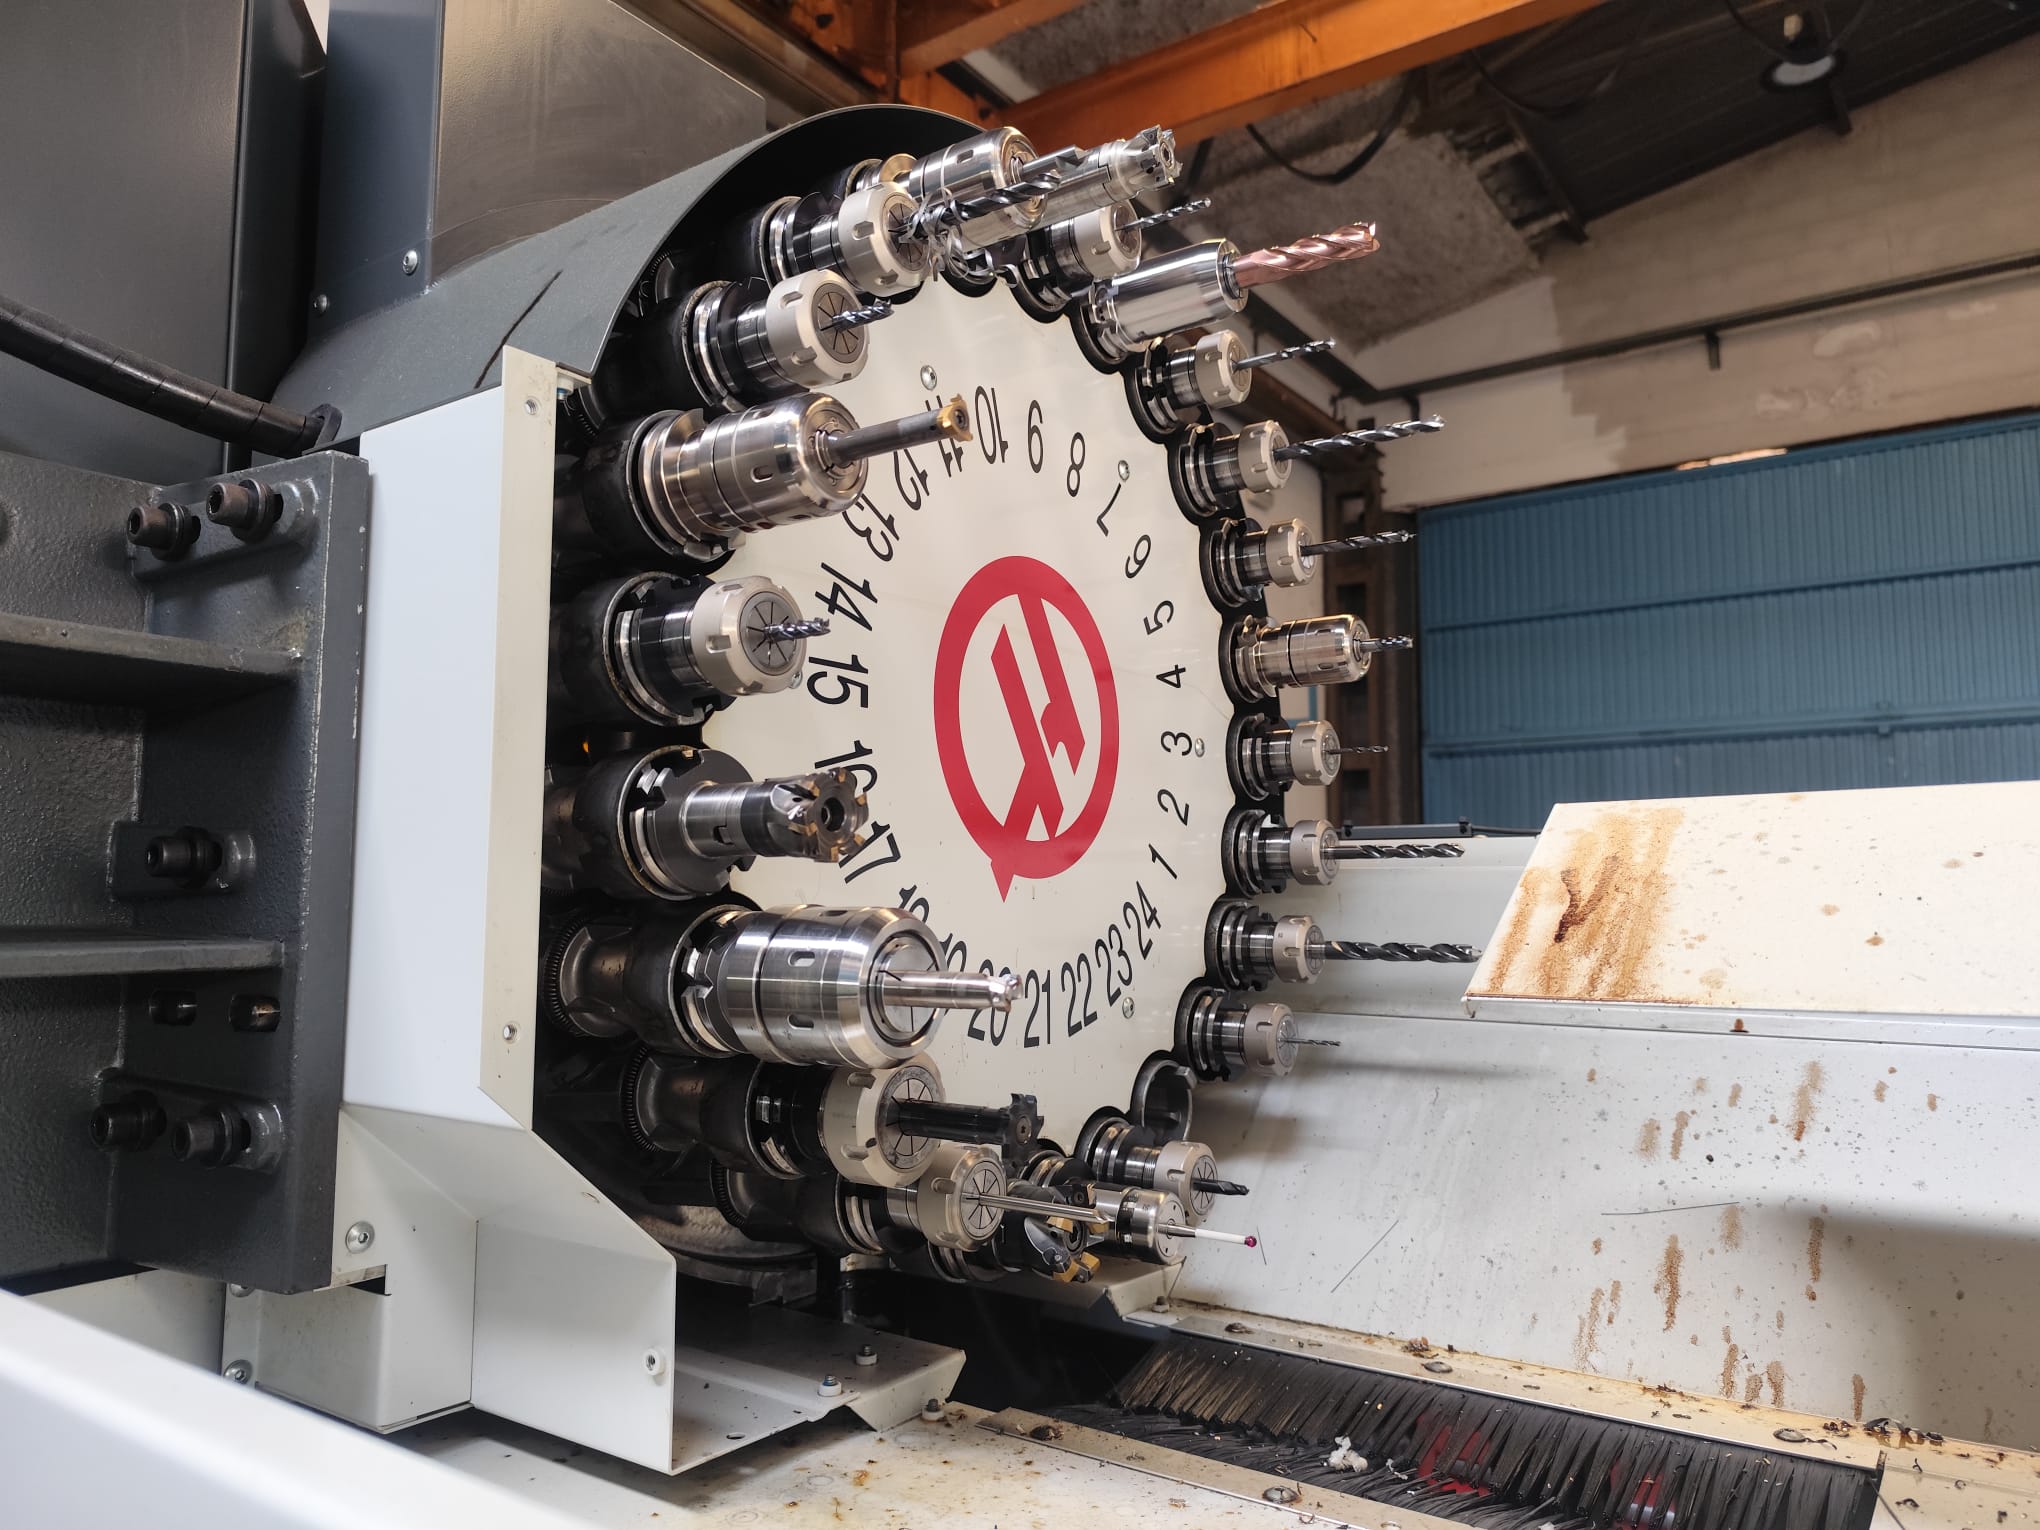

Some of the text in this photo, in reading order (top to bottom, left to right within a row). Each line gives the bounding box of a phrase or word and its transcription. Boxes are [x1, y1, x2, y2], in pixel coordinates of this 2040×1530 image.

[975, 386, 1008, 464] 10
[1028, 400, 1043, 473] 9
[1067, 432, 1085, 497] 8
[842, 494, 899, 561] 13
[1097, 483, 1121, 536] 7
[1126, 535, 1151, 578] 6
[814, 562, 879, 632] 14
[1144, 601, 1174, 635] 5
[807, 653, 869, 708] 15
[1156, 665, 1186, 688] 4
[1161, 731, 1192, 756] 3
[1158, 789, 1189, 826] 2
[838, 821, 901, 884] 17
[1148, 844, 1178, 880] 1
[1123, 881, 1162, 960] 24
[1061, 953, 1097, 1038] 22
[1095, 923, 1133, 1007] 23
[1024, 969, 1051, 1048] 21
